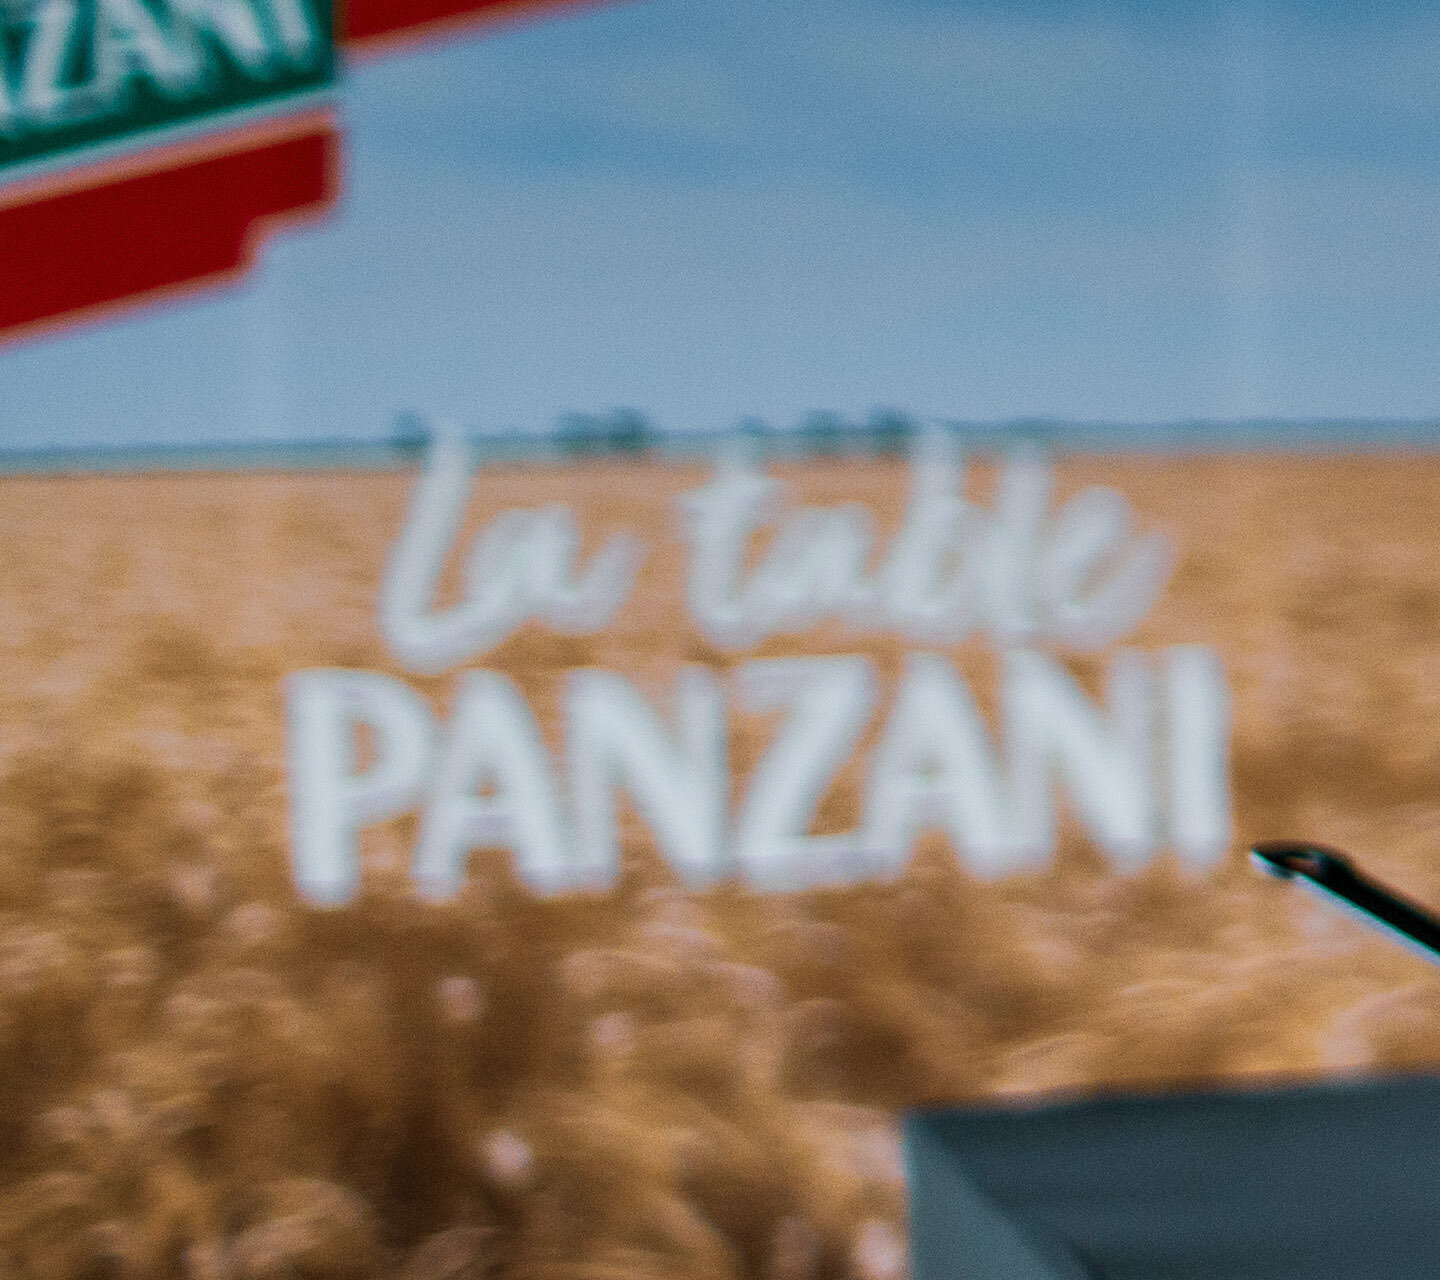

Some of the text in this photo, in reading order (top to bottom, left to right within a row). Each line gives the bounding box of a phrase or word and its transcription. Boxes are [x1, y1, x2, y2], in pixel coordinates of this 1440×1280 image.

[381, 423, 1172, 670] La table
[286, 644, 1230, 905] PANZANI
